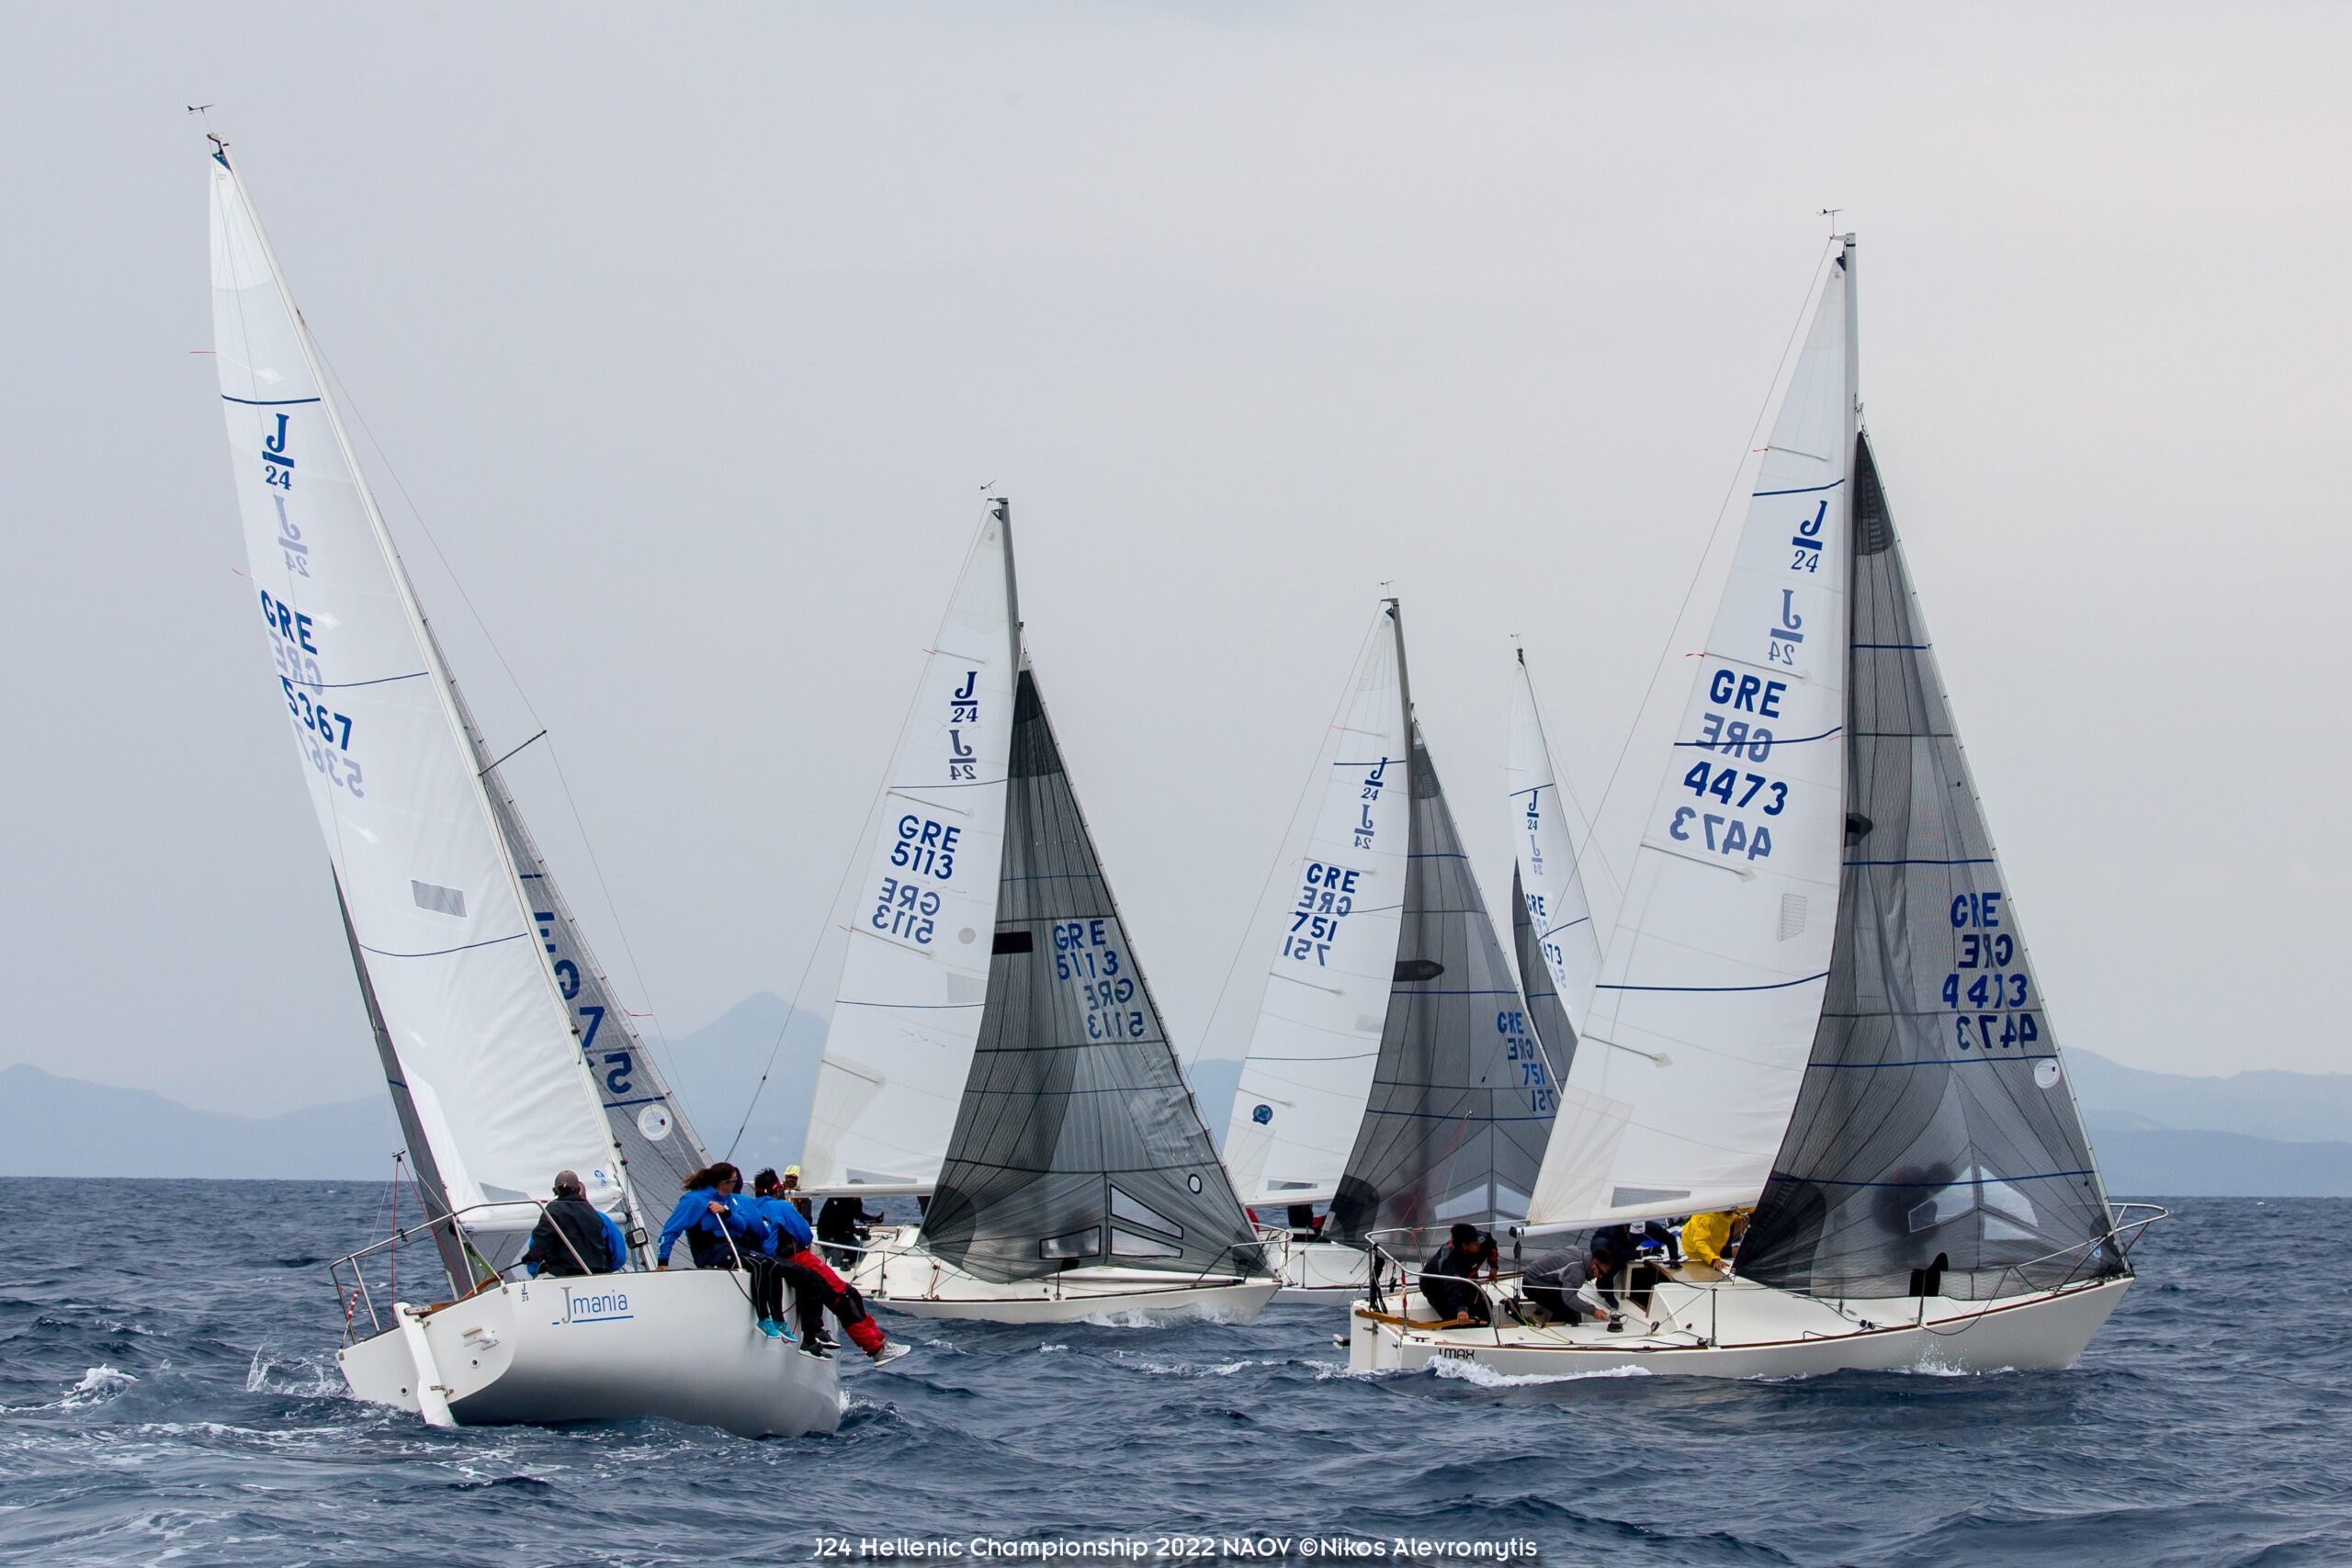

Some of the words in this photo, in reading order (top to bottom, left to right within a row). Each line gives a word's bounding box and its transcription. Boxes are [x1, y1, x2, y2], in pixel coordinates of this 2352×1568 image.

[266, 413, 289, 453] J
[265, 465, 291, 491] 24
[1799, 500, 1827, 536] J
[1791, 550, 1818, 573] 24
[261, 589, 318, 655] GRE
[955, 671, 978, 699] J
[1710, 670, 1786, 718] GRE
[281, 674, 352, 751] 5367
[951, 706, 978, 723] 24
[1370, 757, 1388, 781] J
[1361, 787, 1379, 801] 24
[1529, 790, 1538, 811] J
[1683, 761, 1789, 816] 4473
[898, 814, 961, 853] GRE
[1527, 819, 1538, 830] 24
[890, 840, 954, 880] 5113
[1306, 863, 1361, 894] GRE
[1526, 893, 1546, 917] GRE
[1951, 892, 2001, 929] GRE
[1053, 919, 1106, 951] GRE
[1290, 911, 1338, 942] 751
[1057, 950, 1119, 980] 5113
[1497, 1011, 1524, 1034] GRE
[1521, 1063, 1545, 1086] 751
[560, 1286, 628, 1324] Jmania
